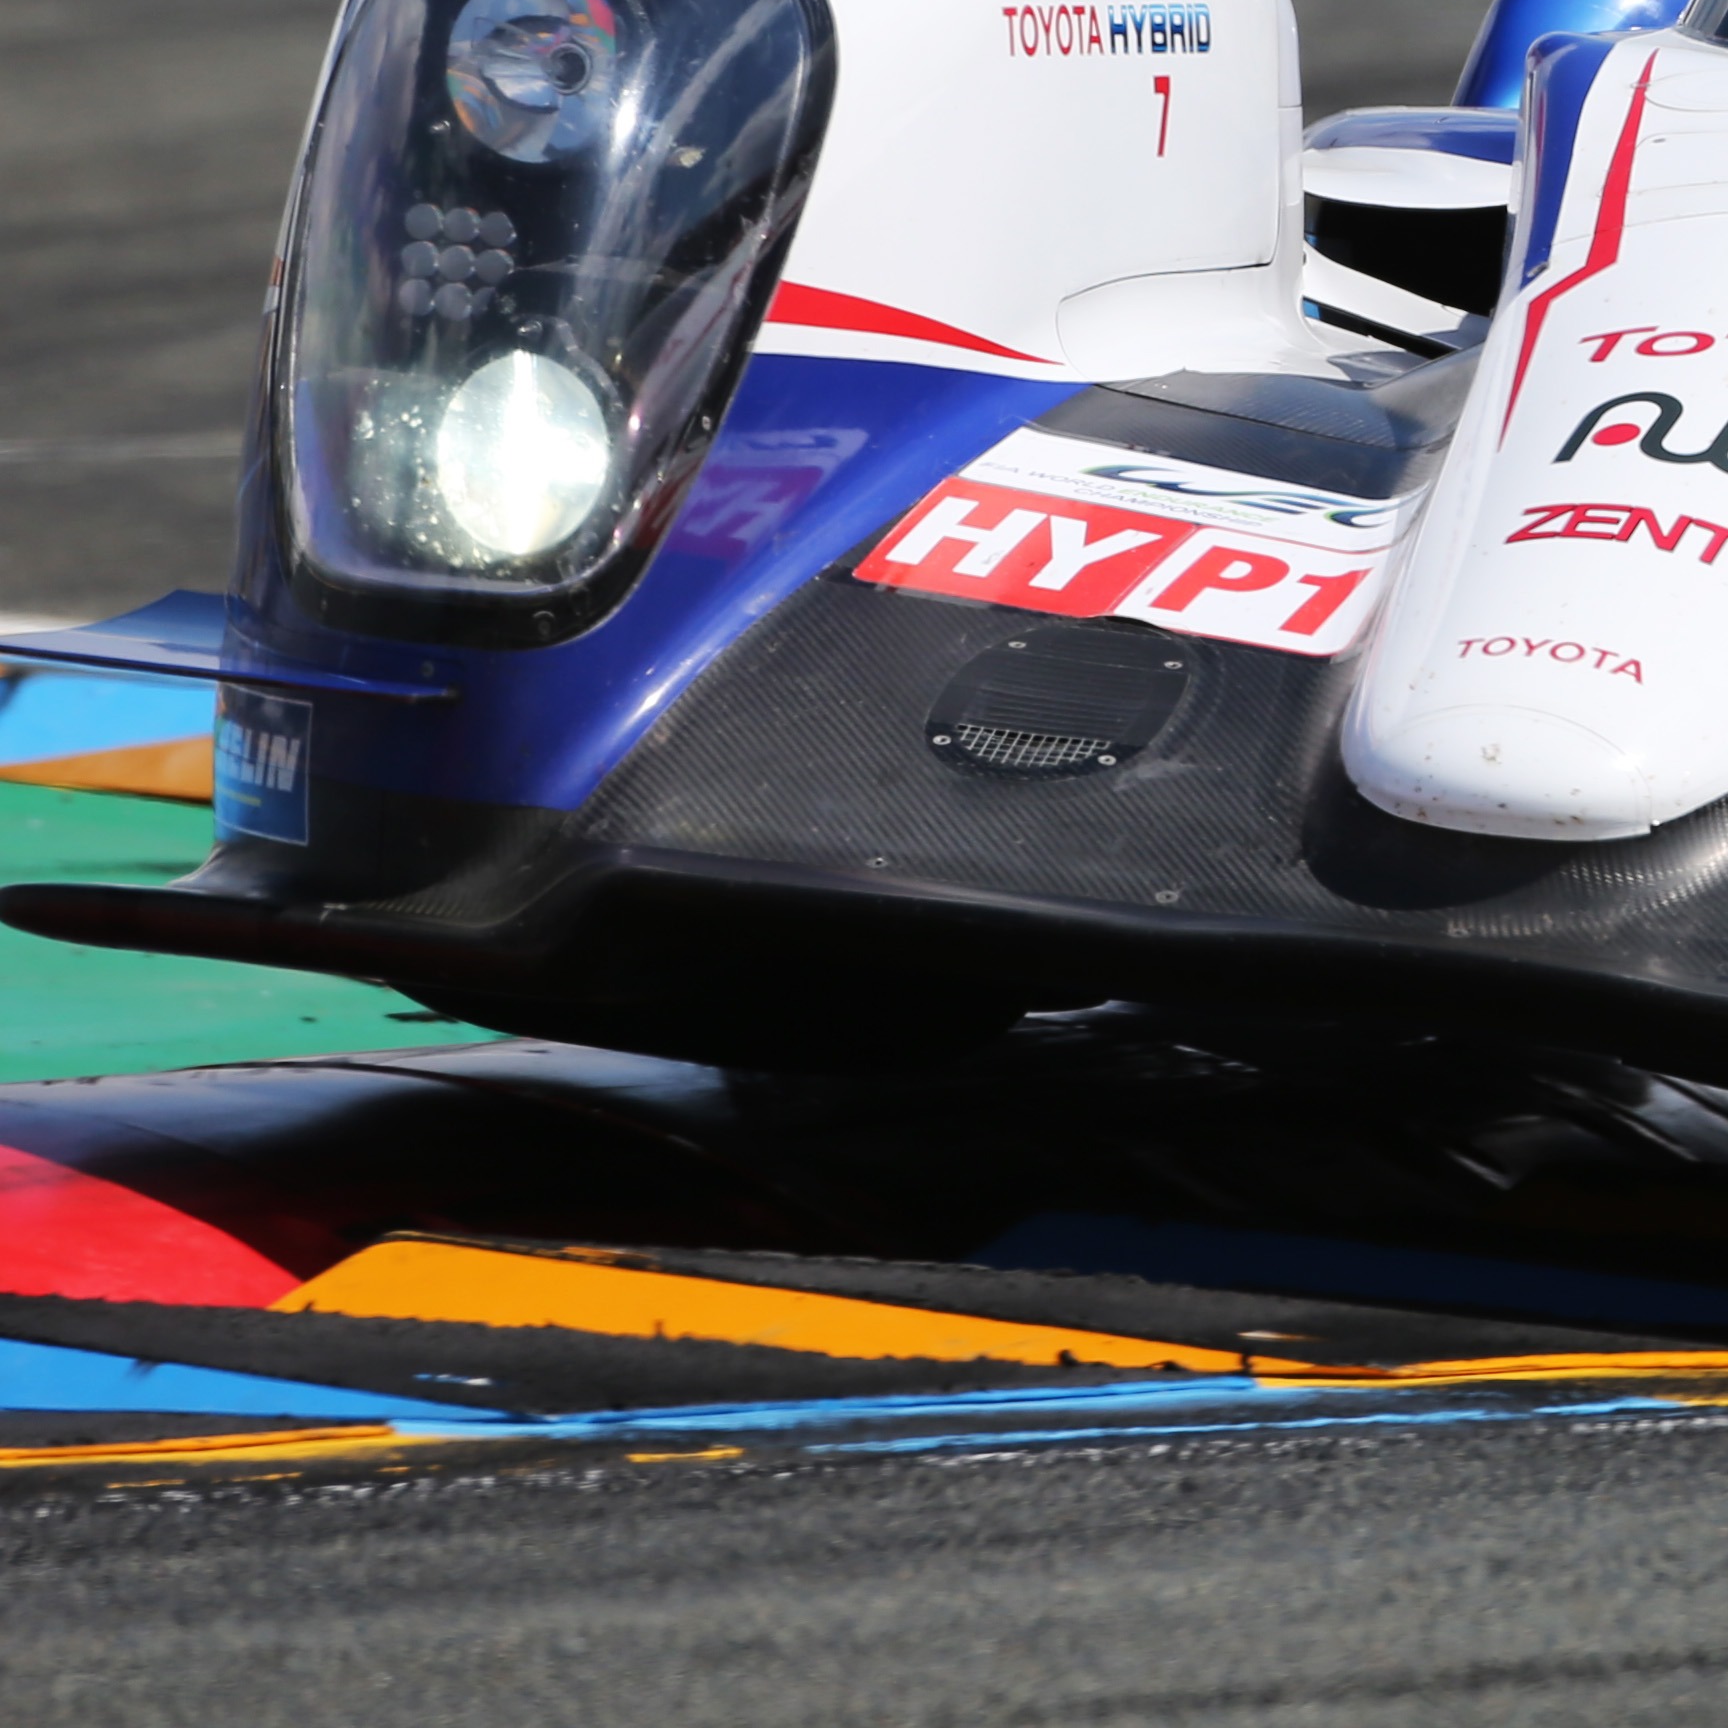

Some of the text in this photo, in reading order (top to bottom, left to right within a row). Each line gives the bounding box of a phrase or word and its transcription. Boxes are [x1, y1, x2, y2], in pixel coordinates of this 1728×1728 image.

[1002, 3, 1211, 57] TOYOTA HYBRID
[1154, 75, 1170, 157] 7
[1073, 487, 1264, 528] CHAMPIONSHIP
[884, 495, 1163, 591] HY
[1146, 544, 1375, 637] P1
[1458, 636, 1643, 685] TOYOTA
